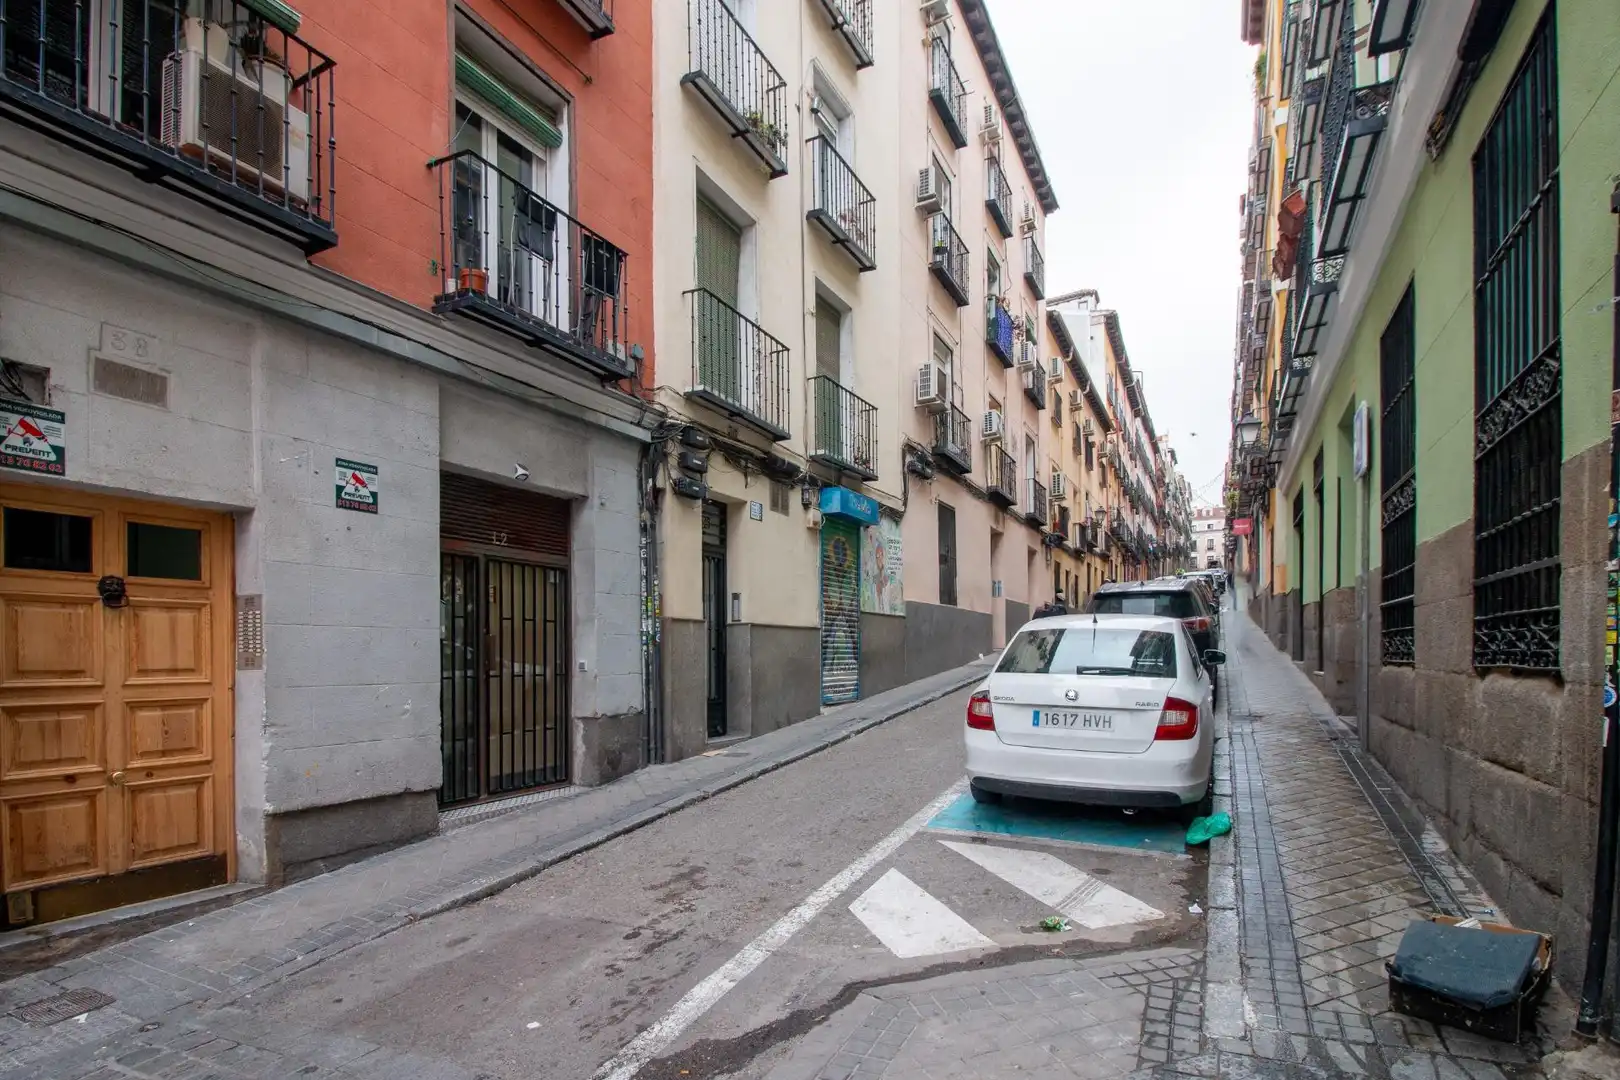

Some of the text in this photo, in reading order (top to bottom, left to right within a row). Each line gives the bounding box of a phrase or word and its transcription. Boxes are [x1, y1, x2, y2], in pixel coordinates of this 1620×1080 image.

[4, 443, 52, 458] PREVENT
[344, 491, 371, 501] PREVENT
[1044, 712, 1112, 729] 1617 HVH
